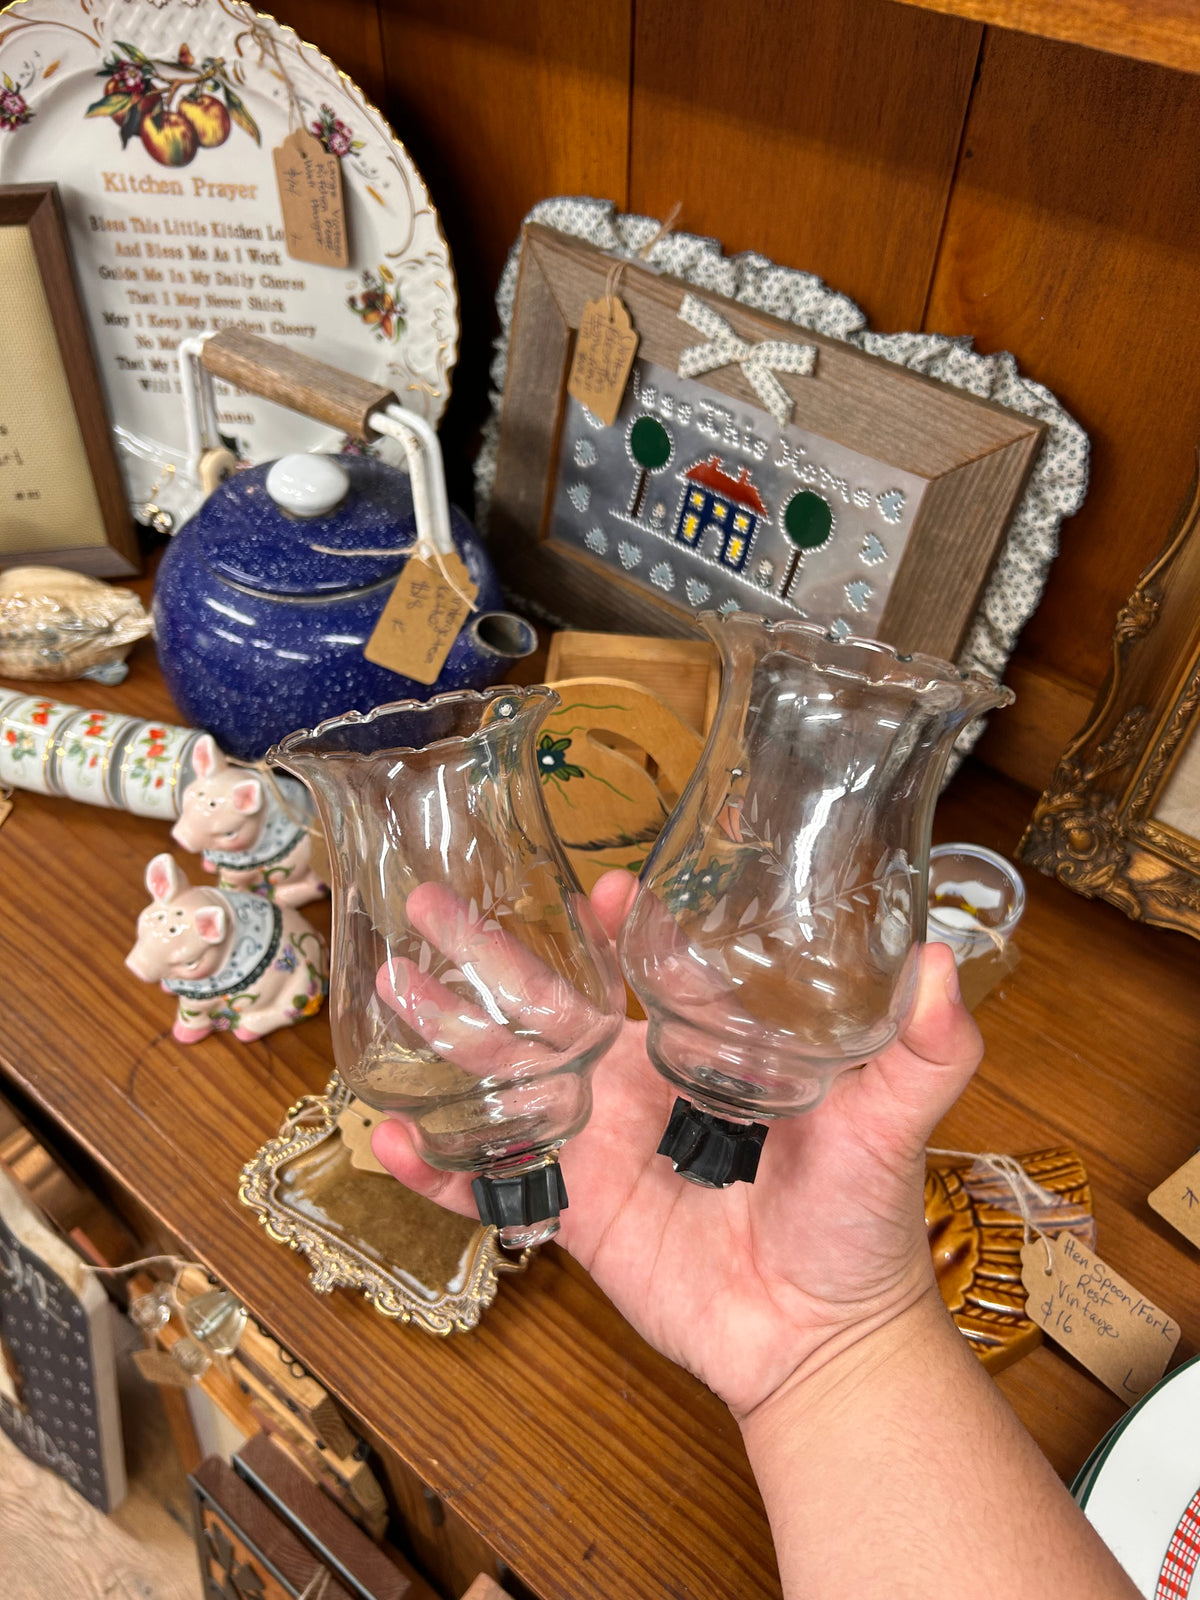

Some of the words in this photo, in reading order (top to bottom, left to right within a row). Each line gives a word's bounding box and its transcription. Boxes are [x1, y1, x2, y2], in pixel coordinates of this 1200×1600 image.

[102, 172, 184, 196] Kitchen
[191, 176, 259, 202] Prayer
[89, 214, 127, 233] Bless
[130, 217, 160, 234] This
[163, 219, 207, 237] Little
[210, 221, 262, 241] Kitchen
[115, 242, 141, 258] And
[146, 243, 183, 260] Bless
[187, 245, 209, 262] Me
[213, 246, 230, 262] As
[236, 248, 243, 263] I
[247, 248, 281, 266] Work
[98, 264, 138, 281] Guide
[142, 266, 164, 282] Me
[169, 268, 187, 284] In
[190, 270, 211, 287] My
[214, 271, 254, 290] Daily
[260, 273, 306, 291] Chores
[126, 289, 158, 305] That
[163, 290, 170, 306] I
[175, 292, 200, 309] May
[204, 293, 242, 311] Never
[102, 310, 130, 329] May
[135, 313, 143, 328] I
[147, 313, 182, 331] Keep
[186, 315, 208, 332] My
[270, 319, 317, 338] Cheery
[135, 335, 154, 350] No
[115, 355, 145, 371] That
[150, 358, 168, 373] My
[697, 398, 769, 461] This
[774, 438, 872, 509] Home
[1063, 1239, 1089, 1270] Hen
[1077, 1274, 1113, 1307] Rest
[1058, 1280, 1119, 1339] Vintage
